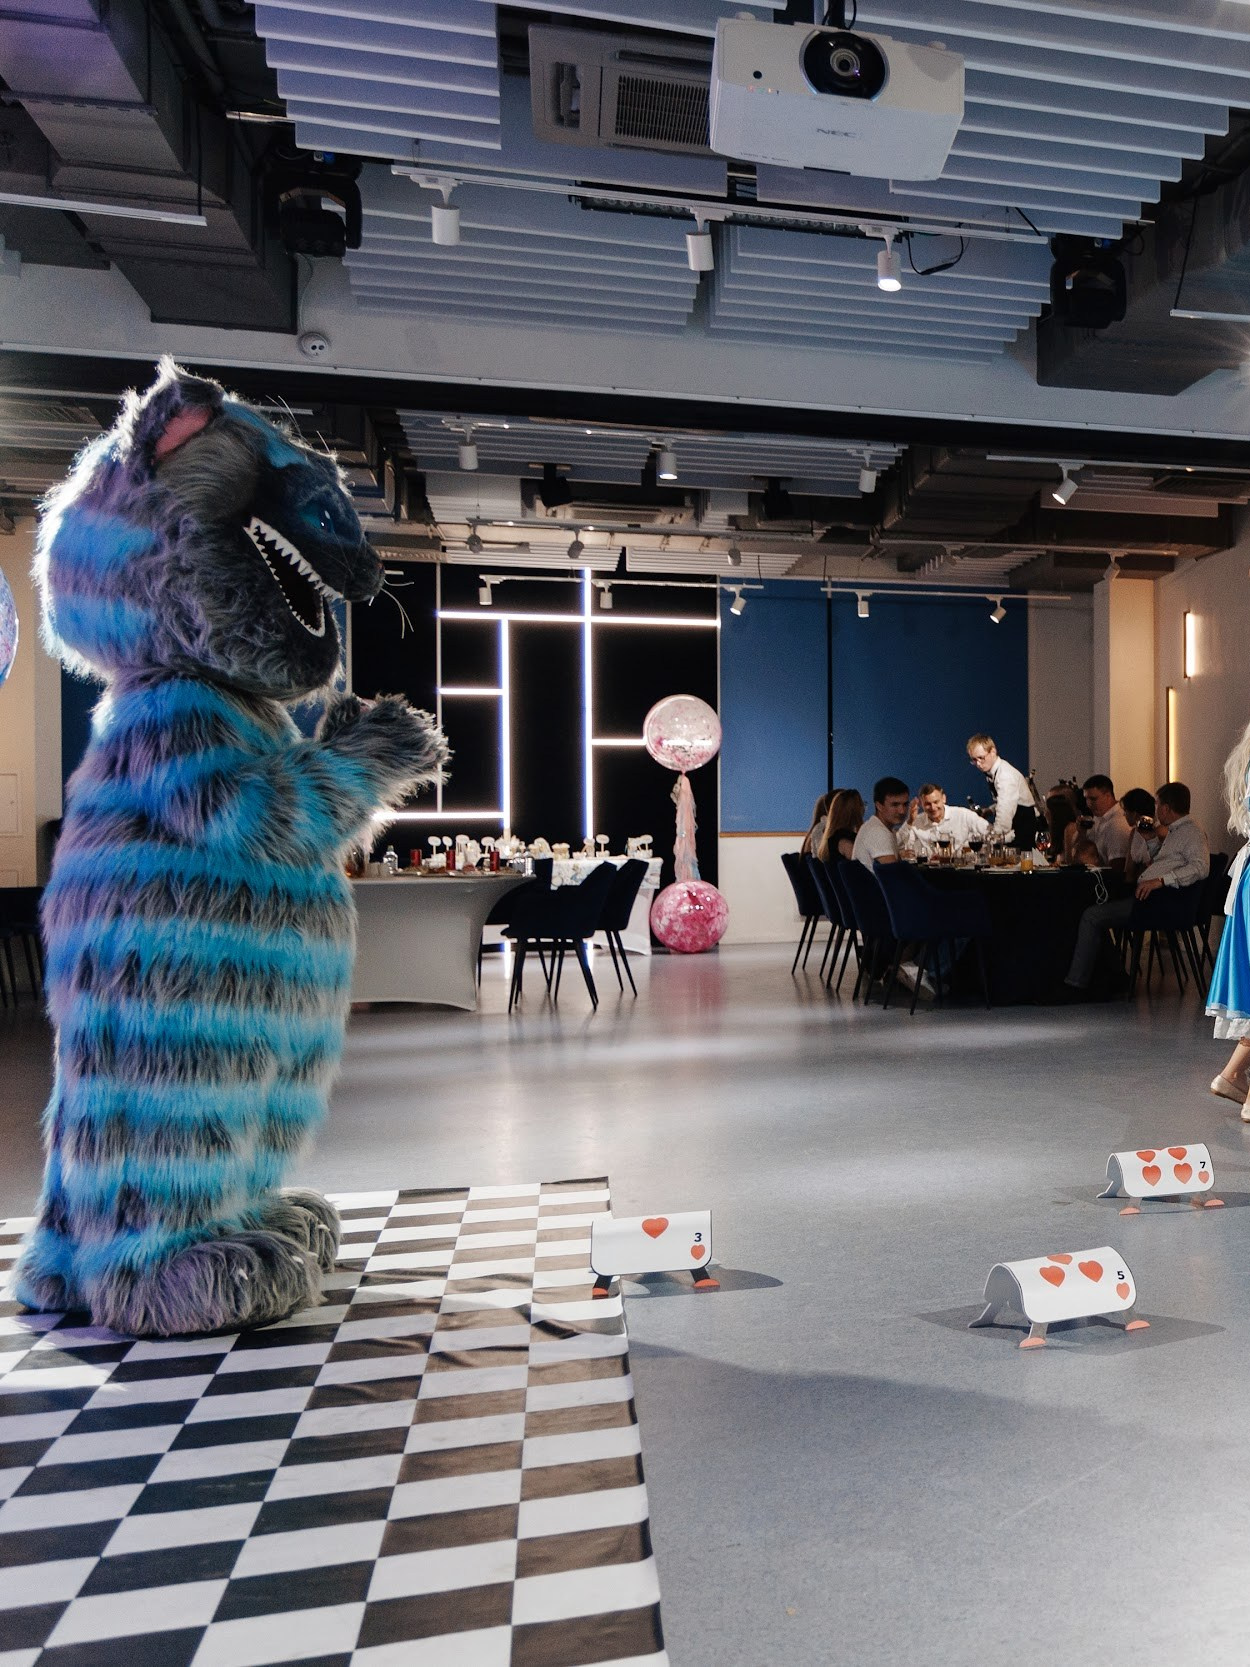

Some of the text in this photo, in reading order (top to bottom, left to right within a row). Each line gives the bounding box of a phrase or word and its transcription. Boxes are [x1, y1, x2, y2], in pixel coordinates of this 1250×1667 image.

[816, 128, 857, 139] NEC
[1199, 1161, 1206, 1169] 7
[694, 1232, 703, 1243] 3
[1116, 1270, 1125, 1280] 5
